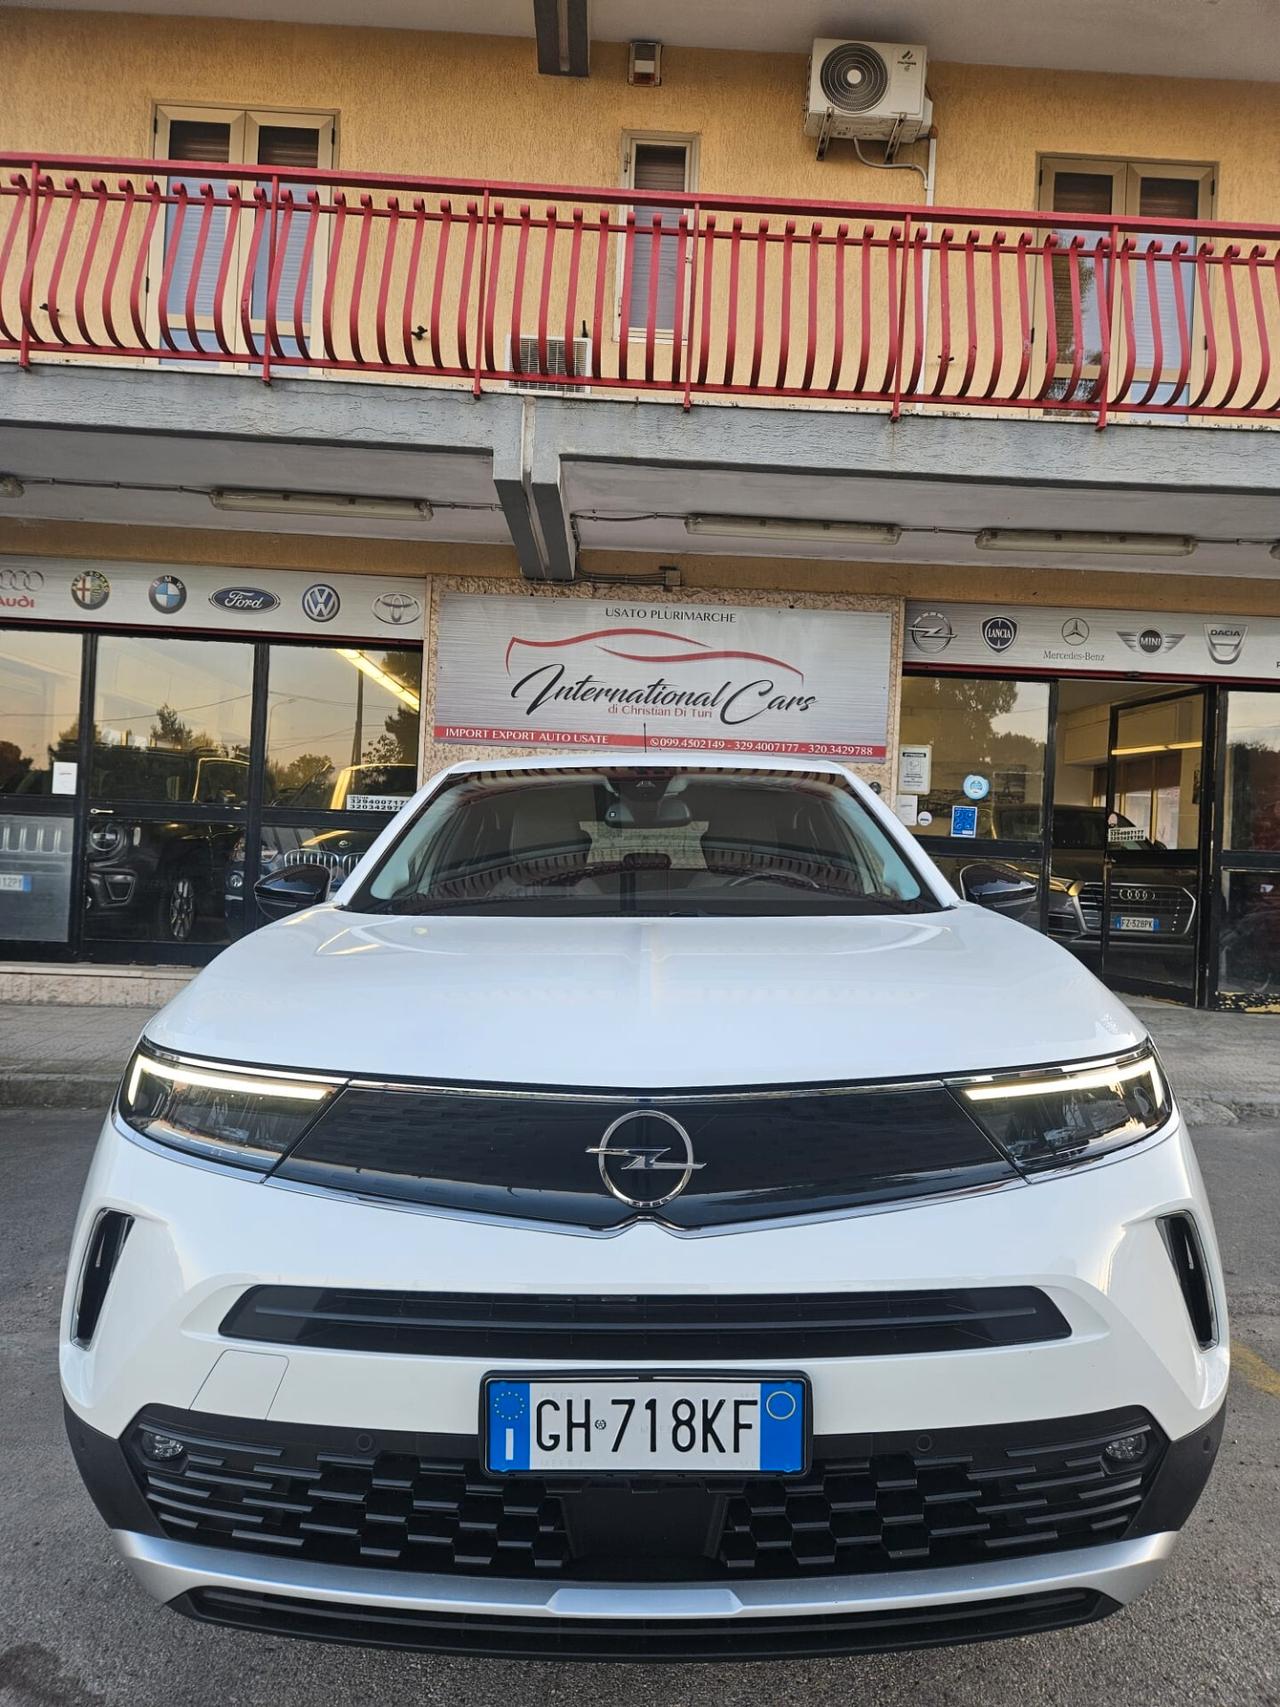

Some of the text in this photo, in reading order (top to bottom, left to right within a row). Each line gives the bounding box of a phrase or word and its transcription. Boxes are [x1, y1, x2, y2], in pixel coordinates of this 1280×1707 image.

[225, 590, 264, 609] Ford
[605, 607, 737, 623] USATO PLURIMARCHE
[988, 628, 1011, 638] LANCIA
[1140, 636, 1161, 646] MINI
[1210, 629, 1241, 637] DACIA
[1042, 650, 1105, 663] Mercedes-Benz
[510, 663, 817, 726] International Cars
[607, 703, 712, 719] di Christian Di Turi
[445, 727, 609, 744] IMPORT EXPORT AUTO USATE
[659, 738, 873, 756] 099.4502149 329.4007177 320.3429788
[350, 798, 409, 806] 329400717
